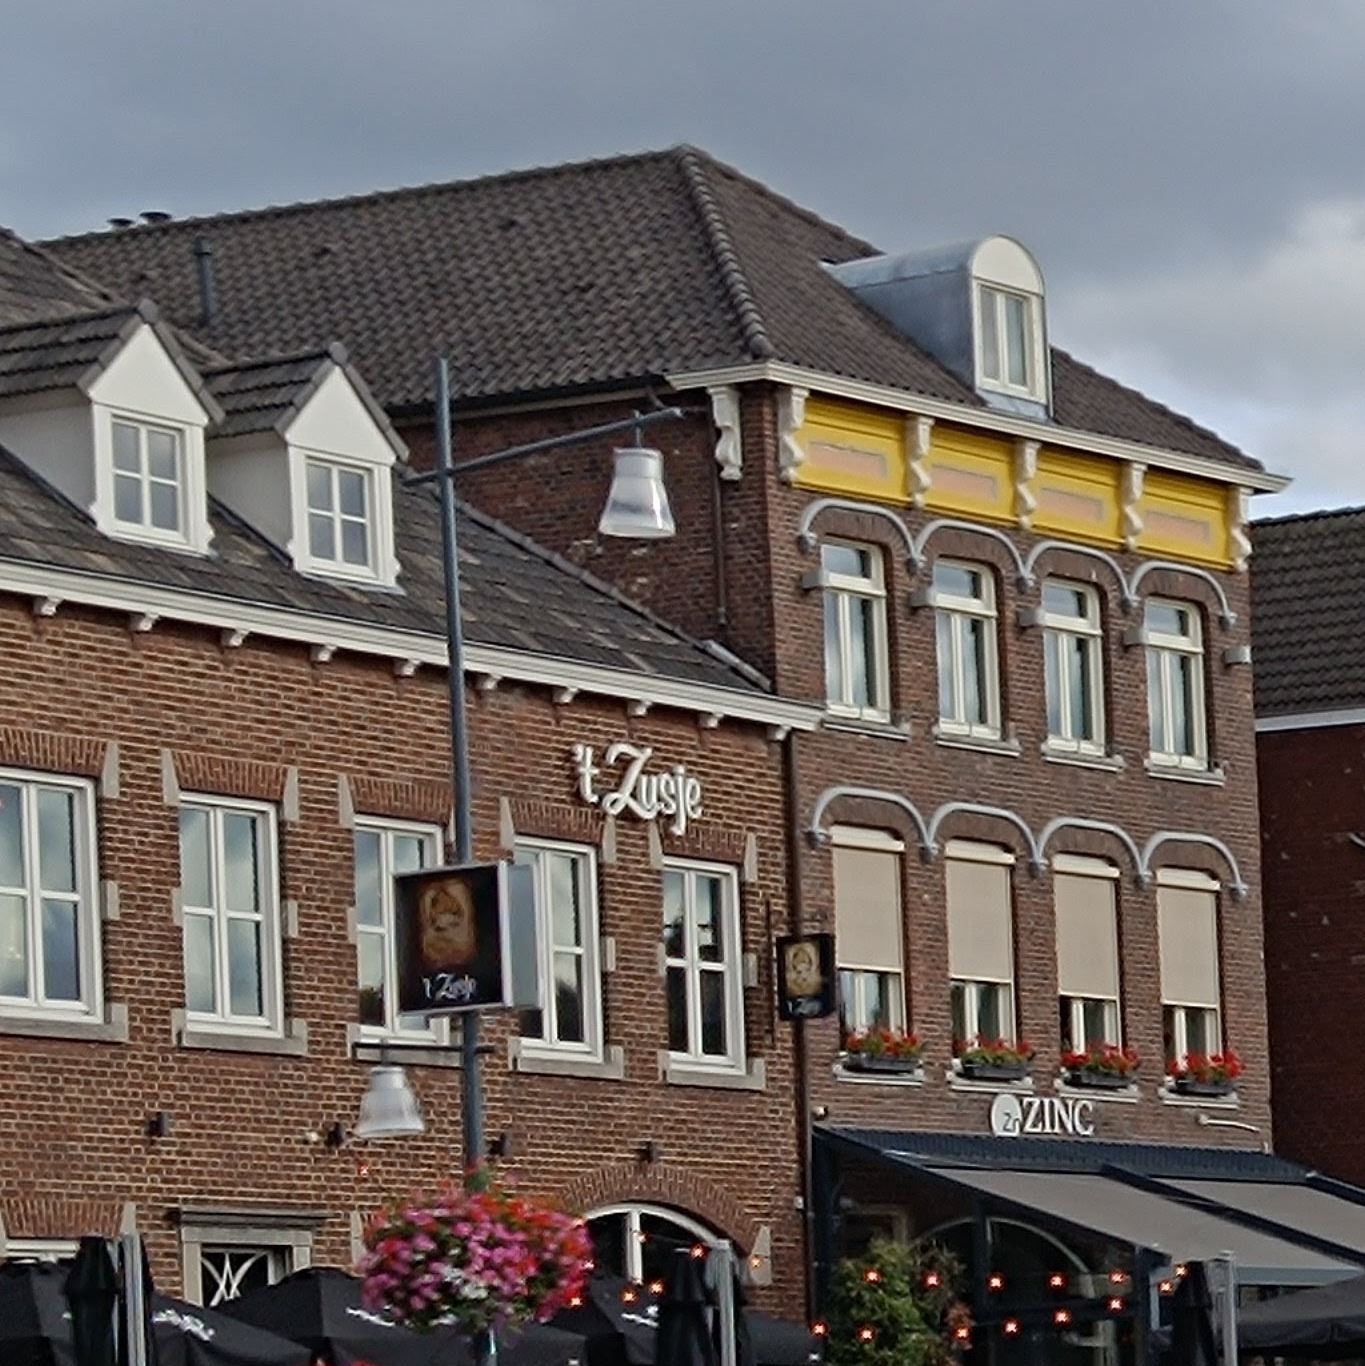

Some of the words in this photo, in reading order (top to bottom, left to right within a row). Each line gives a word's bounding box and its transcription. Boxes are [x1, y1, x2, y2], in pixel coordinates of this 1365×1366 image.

[573, 744, 599, 804] 't
[602, 743, 703, 836] Zusje
[1023, 1097, 1095, 1137] ZINC
